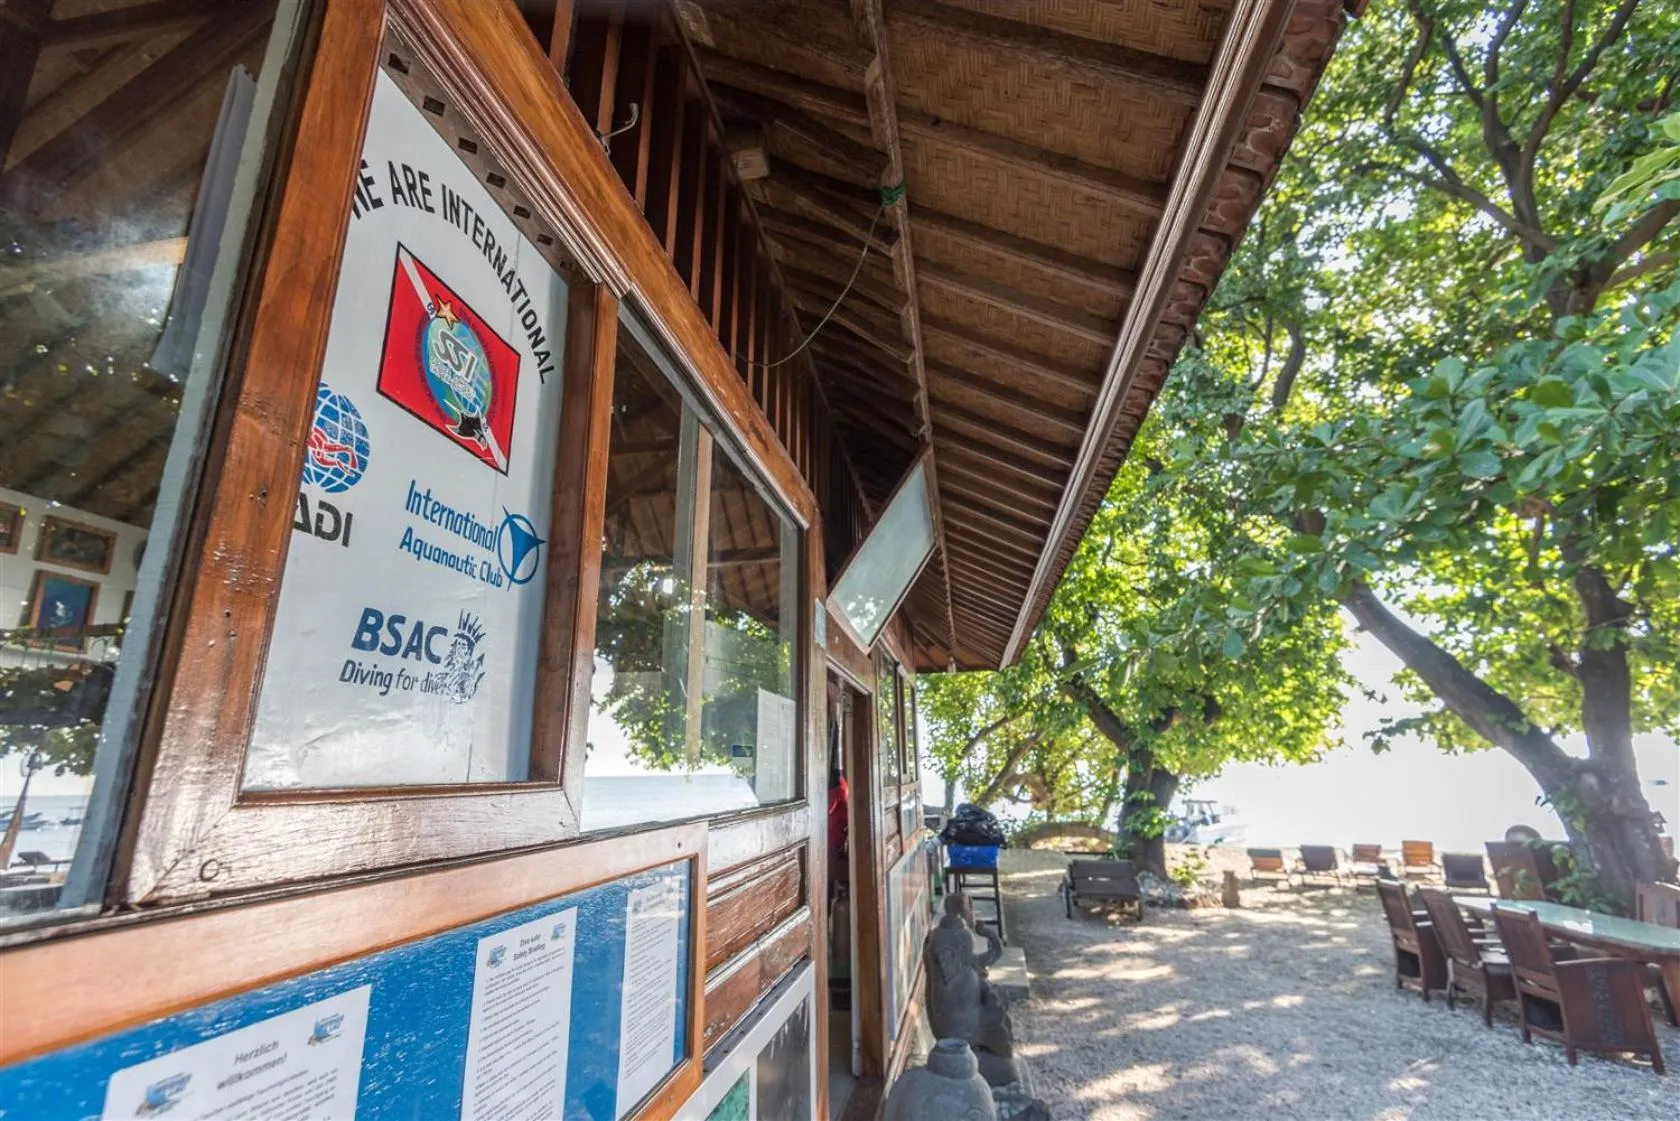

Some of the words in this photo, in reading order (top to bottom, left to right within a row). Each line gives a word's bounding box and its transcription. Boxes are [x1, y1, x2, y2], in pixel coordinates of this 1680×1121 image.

[388, 160, 435, 214] ARE
[441, 183, 555, 384] INTERNATIONAL
[432, 329, 477, 383] SSI
[293, 492, 353, 548] ADI
[406, 479, 499, 552] International
[399, 526, 477, 579] Aquanautic
[479, 560, 503, 588] Club
[351, 607, 448, 665] BSAC
[339, 659, 393, 697] Diving
[395, 667, 418, 691] for
[233, 1040, 279, 1066] Herzlich
